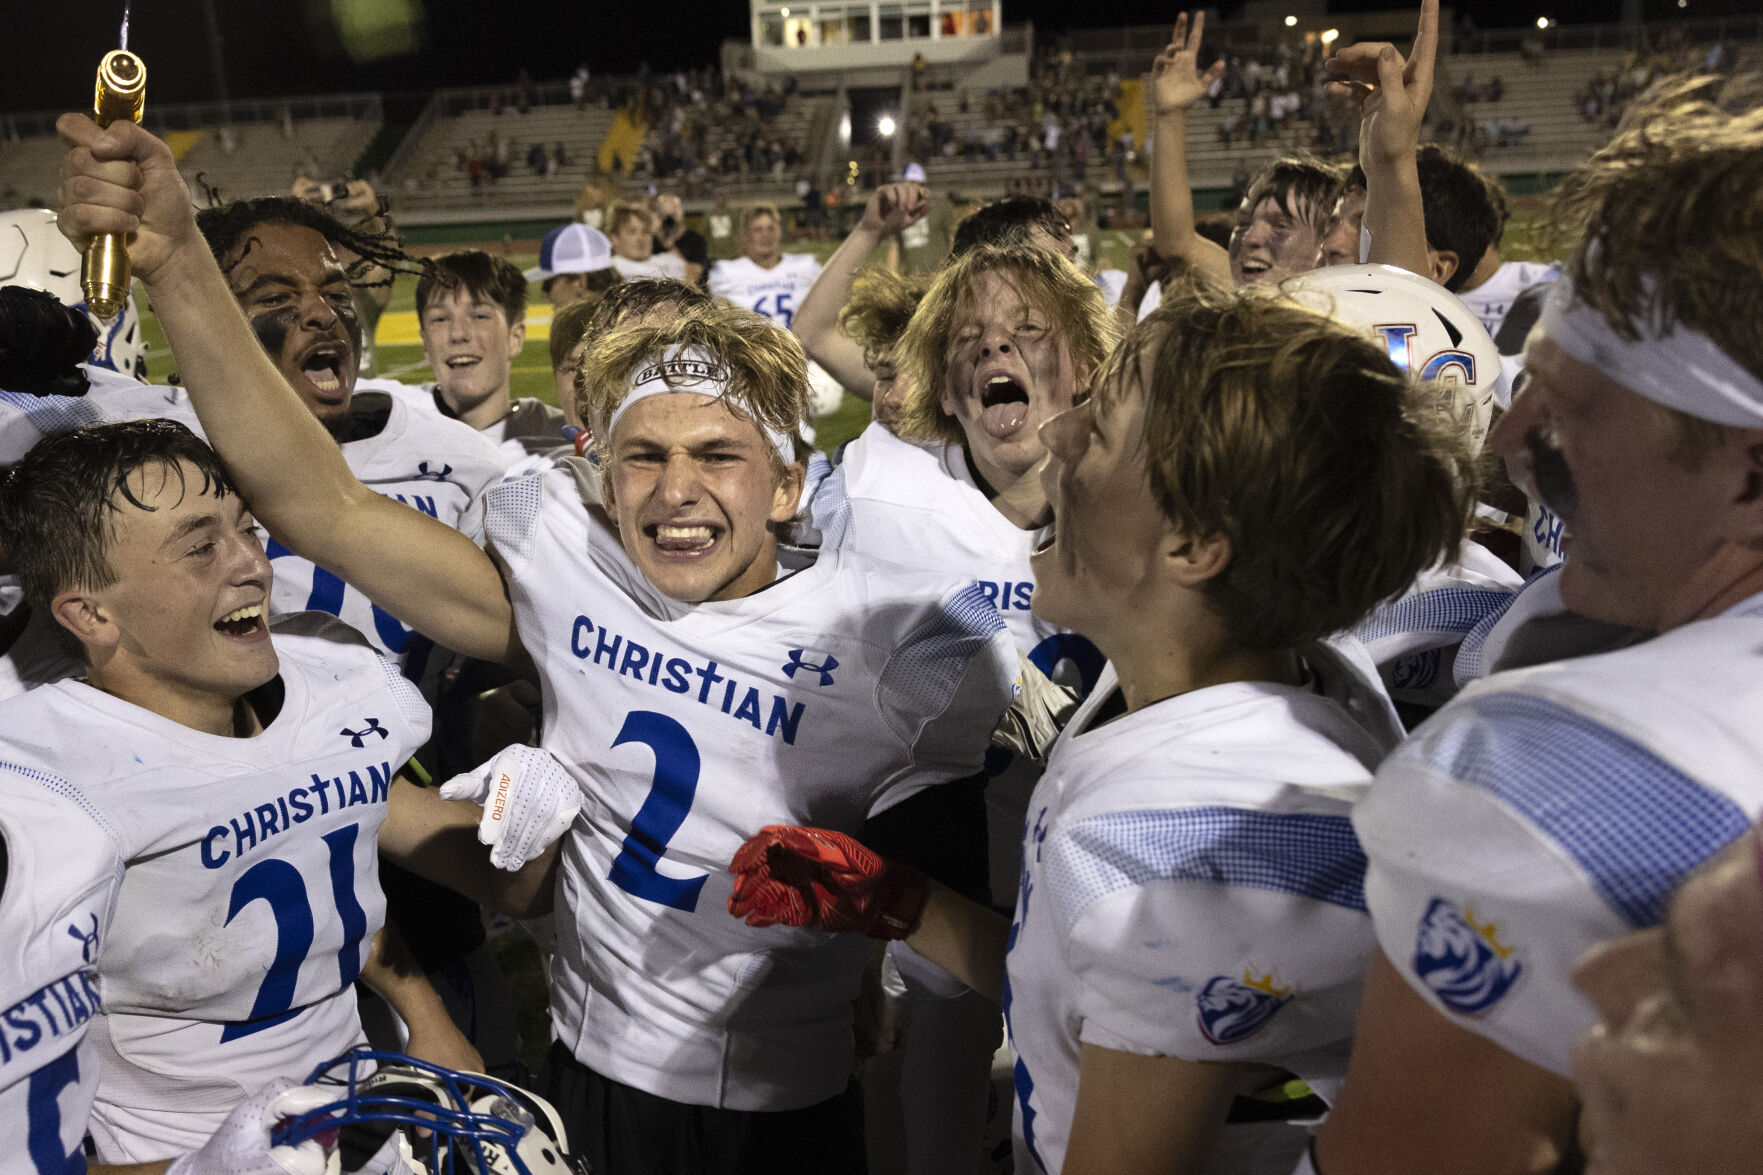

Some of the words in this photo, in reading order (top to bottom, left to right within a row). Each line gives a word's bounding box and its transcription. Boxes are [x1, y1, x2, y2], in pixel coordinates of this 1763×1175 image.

[641, 363, 718, 381] BATTLE
[571, 615, 806, 746] CHRISTIAN
[200, 761, 391, 870] CHRISTIAN
[491, 773, 511, 822] ADIZERO
[608, 710, 709, 913] 2
[219, 822, 367, 1045] 21
